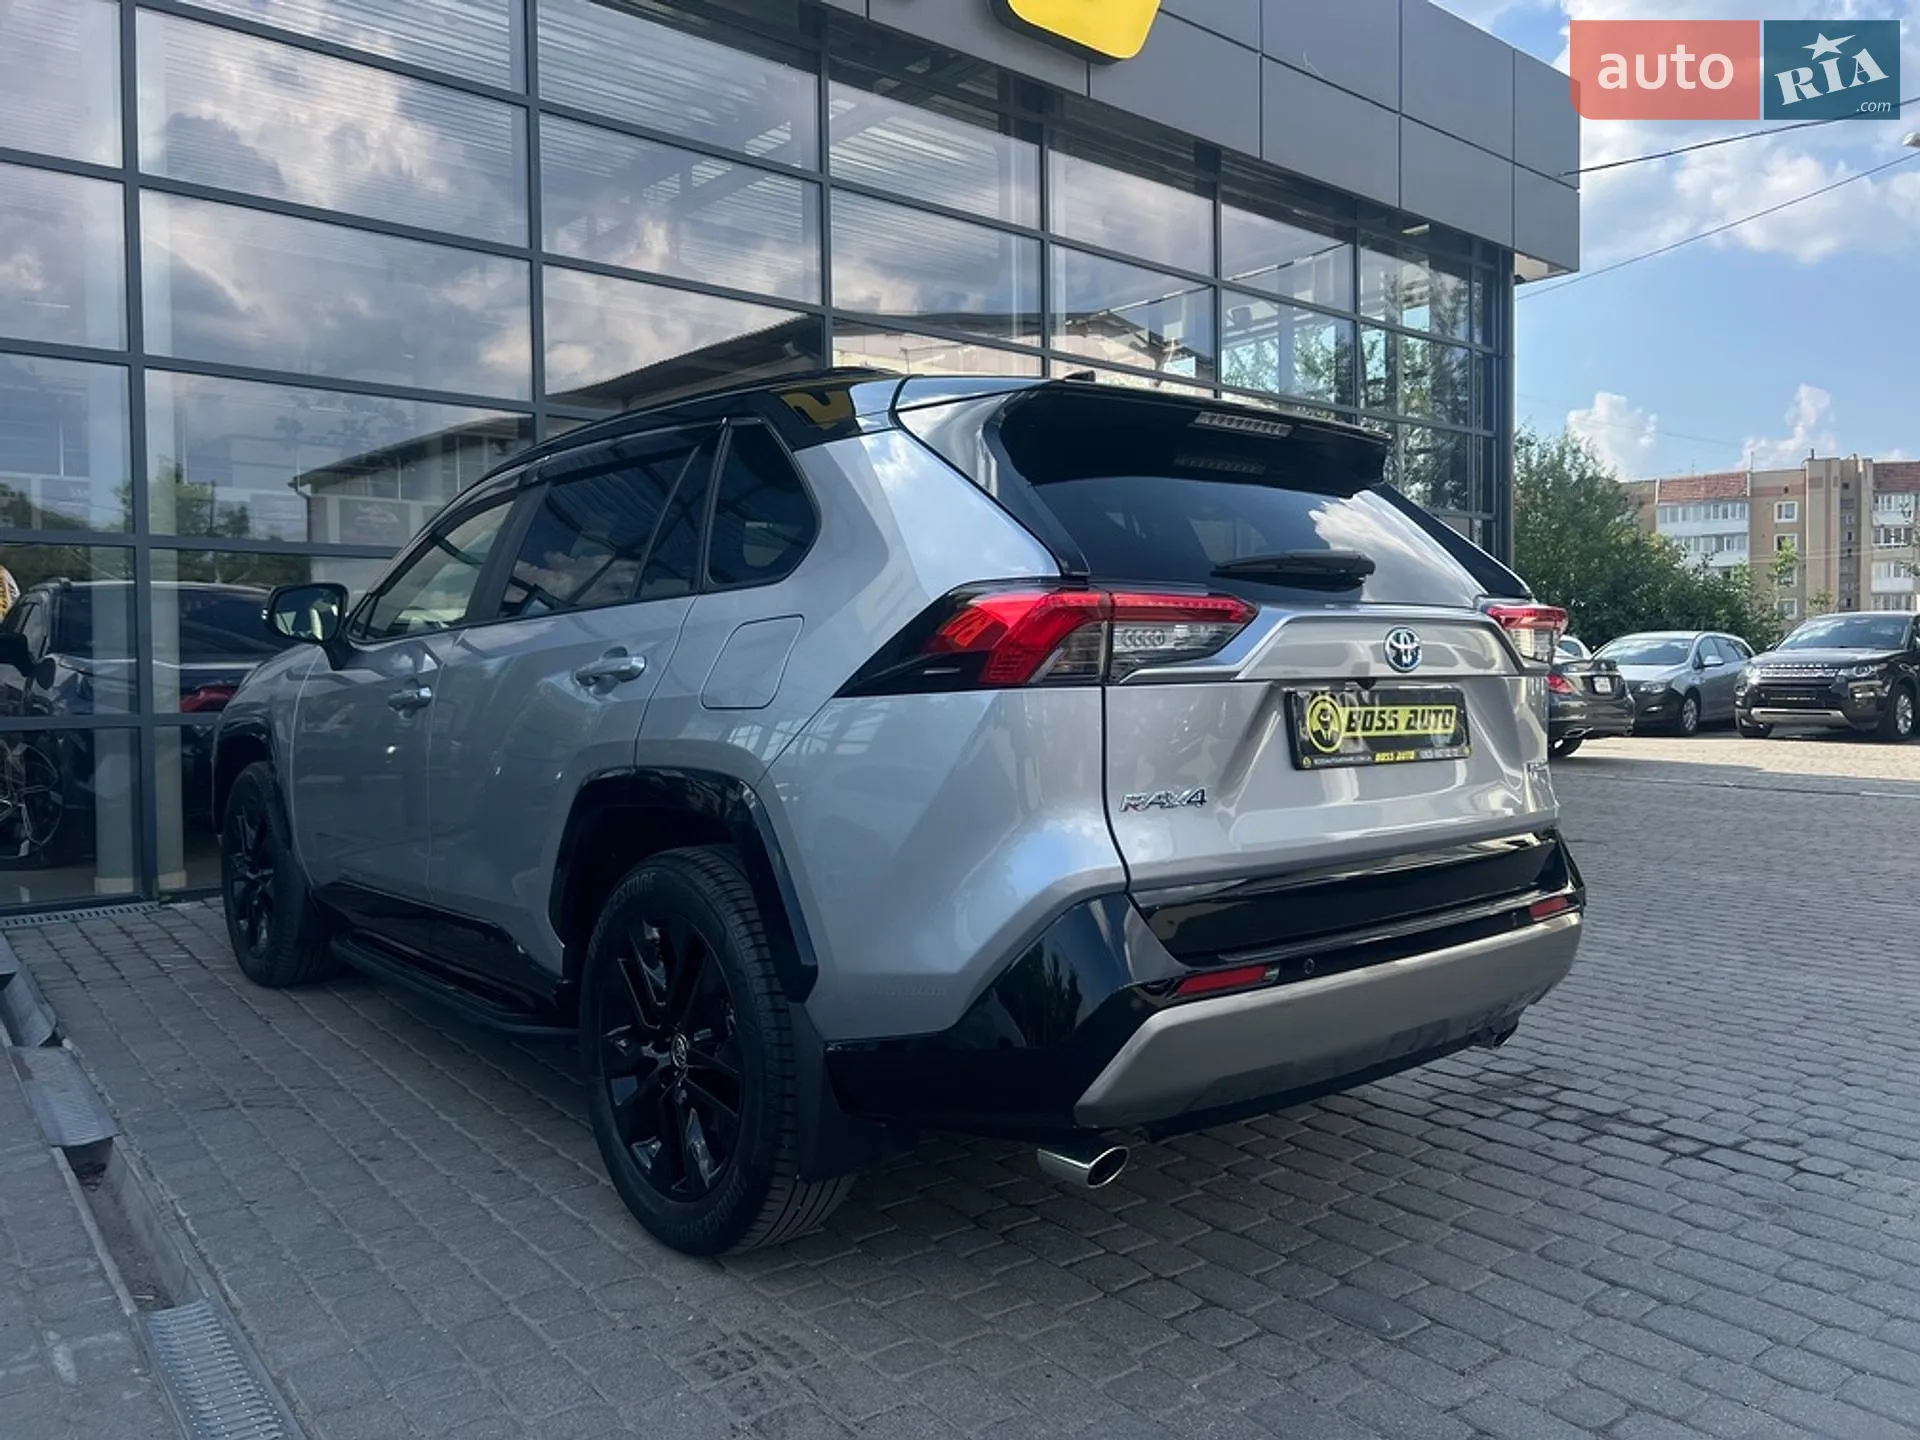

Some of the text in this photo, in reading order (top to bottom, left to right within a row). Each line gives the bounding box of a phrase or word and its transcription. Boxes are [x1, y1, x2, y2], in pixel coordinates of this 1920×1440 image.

[1345, 709, 1453, 732] BOSS AUTO
[1119, 787, 1207, 812] RAV4
